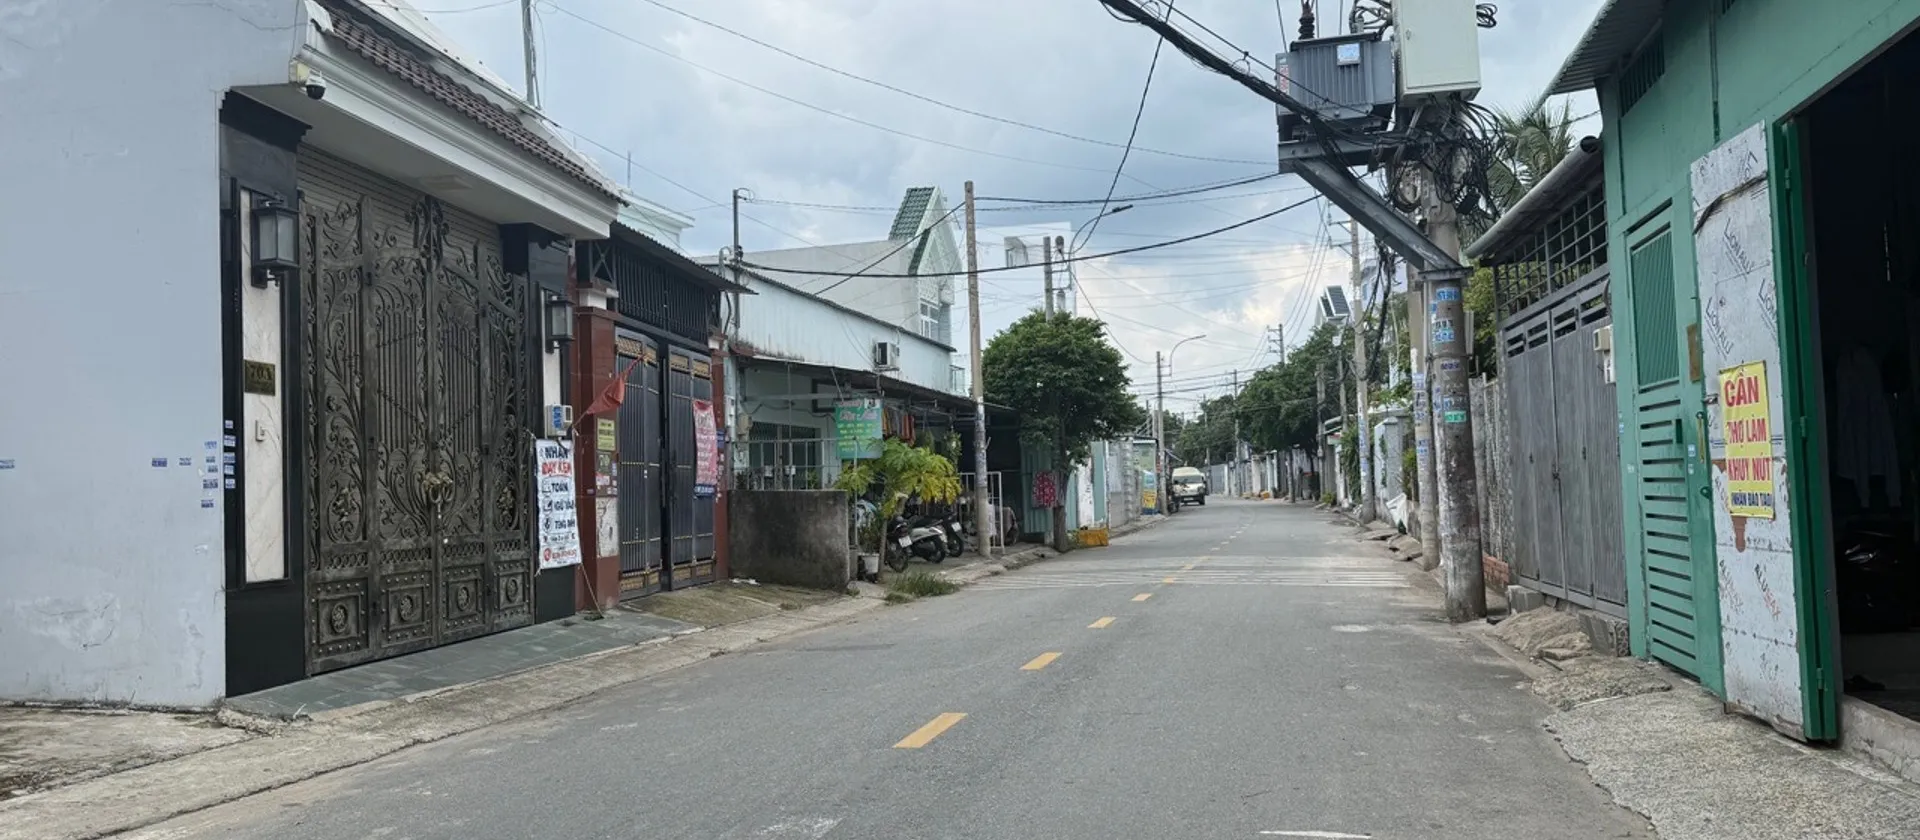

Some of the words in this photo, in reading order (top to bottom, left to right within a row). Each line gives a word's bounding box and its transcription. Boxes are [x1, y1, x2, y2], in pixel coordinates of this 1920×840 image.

[1724, 373, 1759, 407] CẦN
[1747, 414, 1766, 442] LÀM
[1728, 457, 1749, 481] KHUY
[1752, 452, 1771, 481] NÚT
